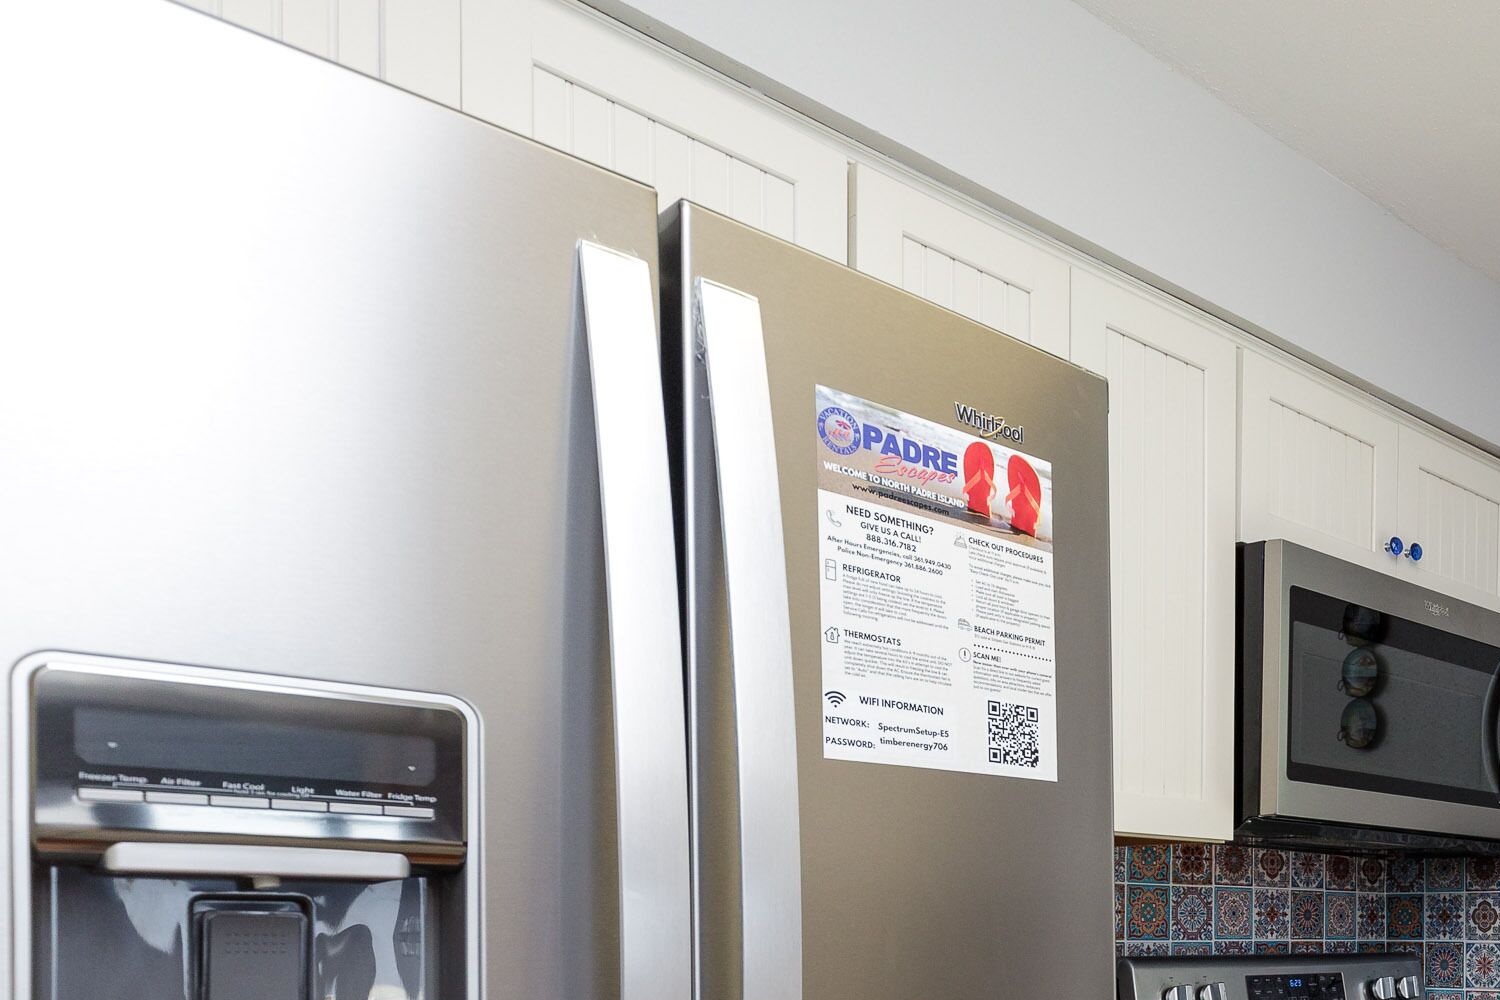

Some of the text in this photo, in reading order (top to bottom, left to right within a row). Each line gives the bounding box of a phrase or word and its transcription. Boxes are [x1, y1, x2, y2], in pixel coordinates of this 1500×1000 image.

[954, 401, 1025, 443] Whirlpool
[862, 423, 958, 478] PADRE
[874, 455, 957, 486] Escapes
[823, 460, 965, 508] WELCOME TO NORTH PADRE ISLAND
[851, 483, 950, 517] www.padreescapes.com
[846, 504, 934, 536] NEED SOMETHING?
[827, 535, 843, 543] After
[844, 539, 863, 549] Hours
[860, 521, 879, 533] GIVE
[881, 526, 891, 536] US
[900, 531, 922, 543] CALL!
[837, 545, 855, 555] Police
[866, 533, 917, 553] 888.316.7182
[968, 536, 990, 548] CHECK
[991, 543, 1004, 552] OUT
[1005, 546, 1044, 564] PROCEDURES
[842, 563, 901, 583] REFRIGERATOR
[844, 629, 902, 647] THERMOSTATS
[974, 625, 995, 636] BEACH
[996, 630, 1024, 642] PARKING
[1024, 636, 1046, 647] PERMIT
[973, 651, 990, 660] SCAN
[859, 695, 944, 716] WIFI INFORMATION
[825, 715, 950, 738] NETWORK: SpectrumSetup-E5
[825, 736, 949, 752] PASSWORD: timberenergy706
[160, 776, 202, 786] Air Filter
[222, 781, 265, 790] Fast Cool
[291, 786, 315, 795] Light
[335, 789, 383, 799] Water Filter
[387, 792, 437, 803] Fridge Temp
